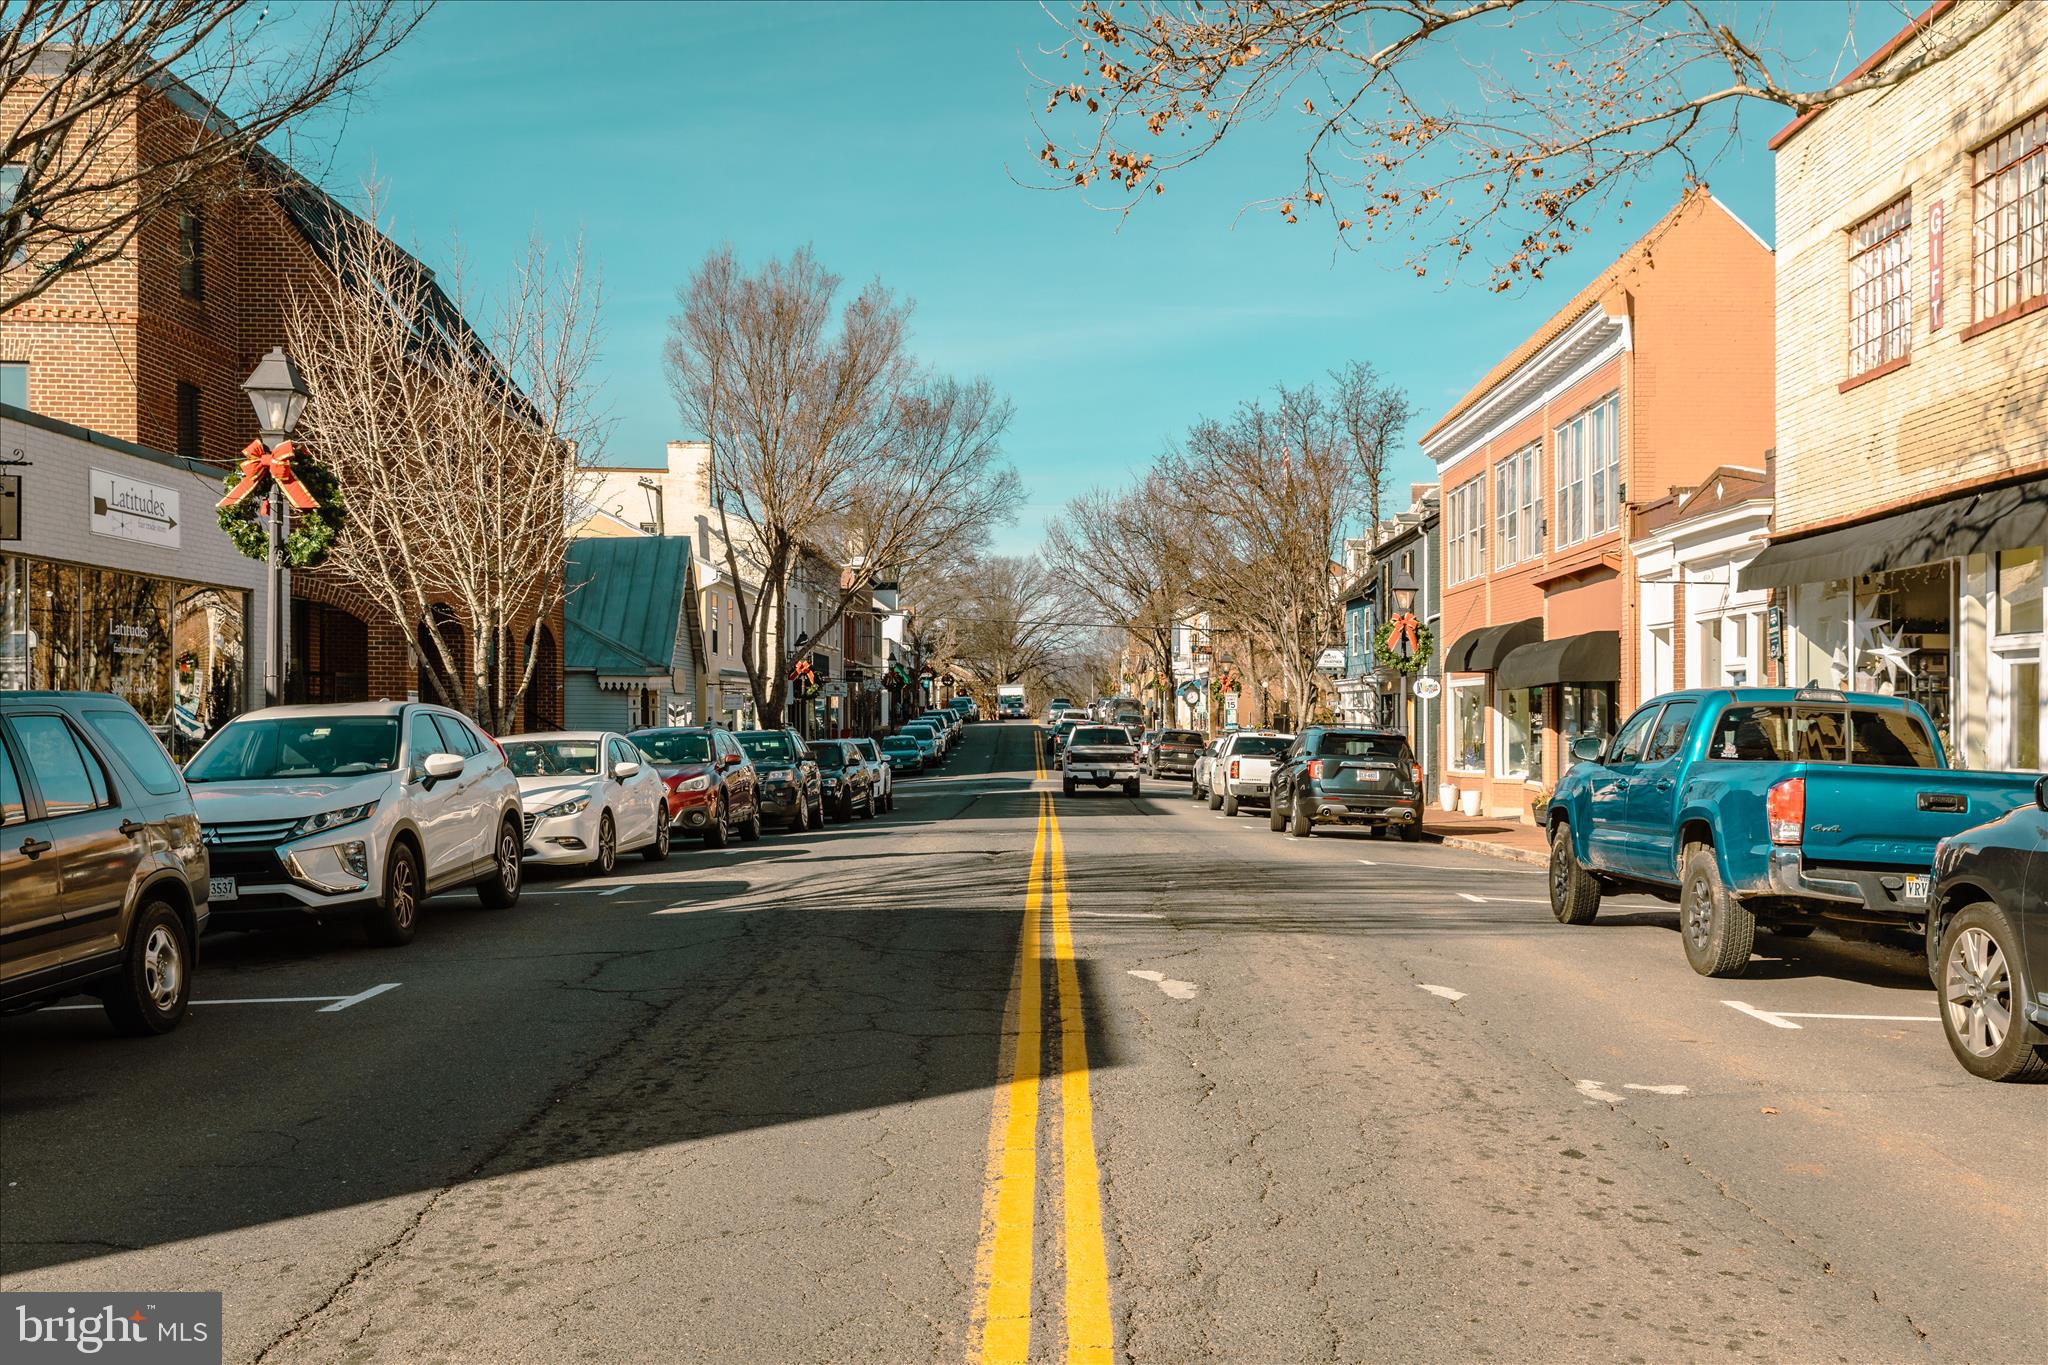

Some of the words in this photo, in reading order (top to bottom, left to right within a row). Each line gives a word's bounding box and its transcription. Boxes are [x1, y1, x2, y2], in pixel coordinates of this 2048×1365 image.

[1930, 206, 1941, 326] GIFT
[111, 480, 166, 517] Latitudes
[109, 617, 149, 638] Latitudes
[210, 882, 233, 895] 3537
